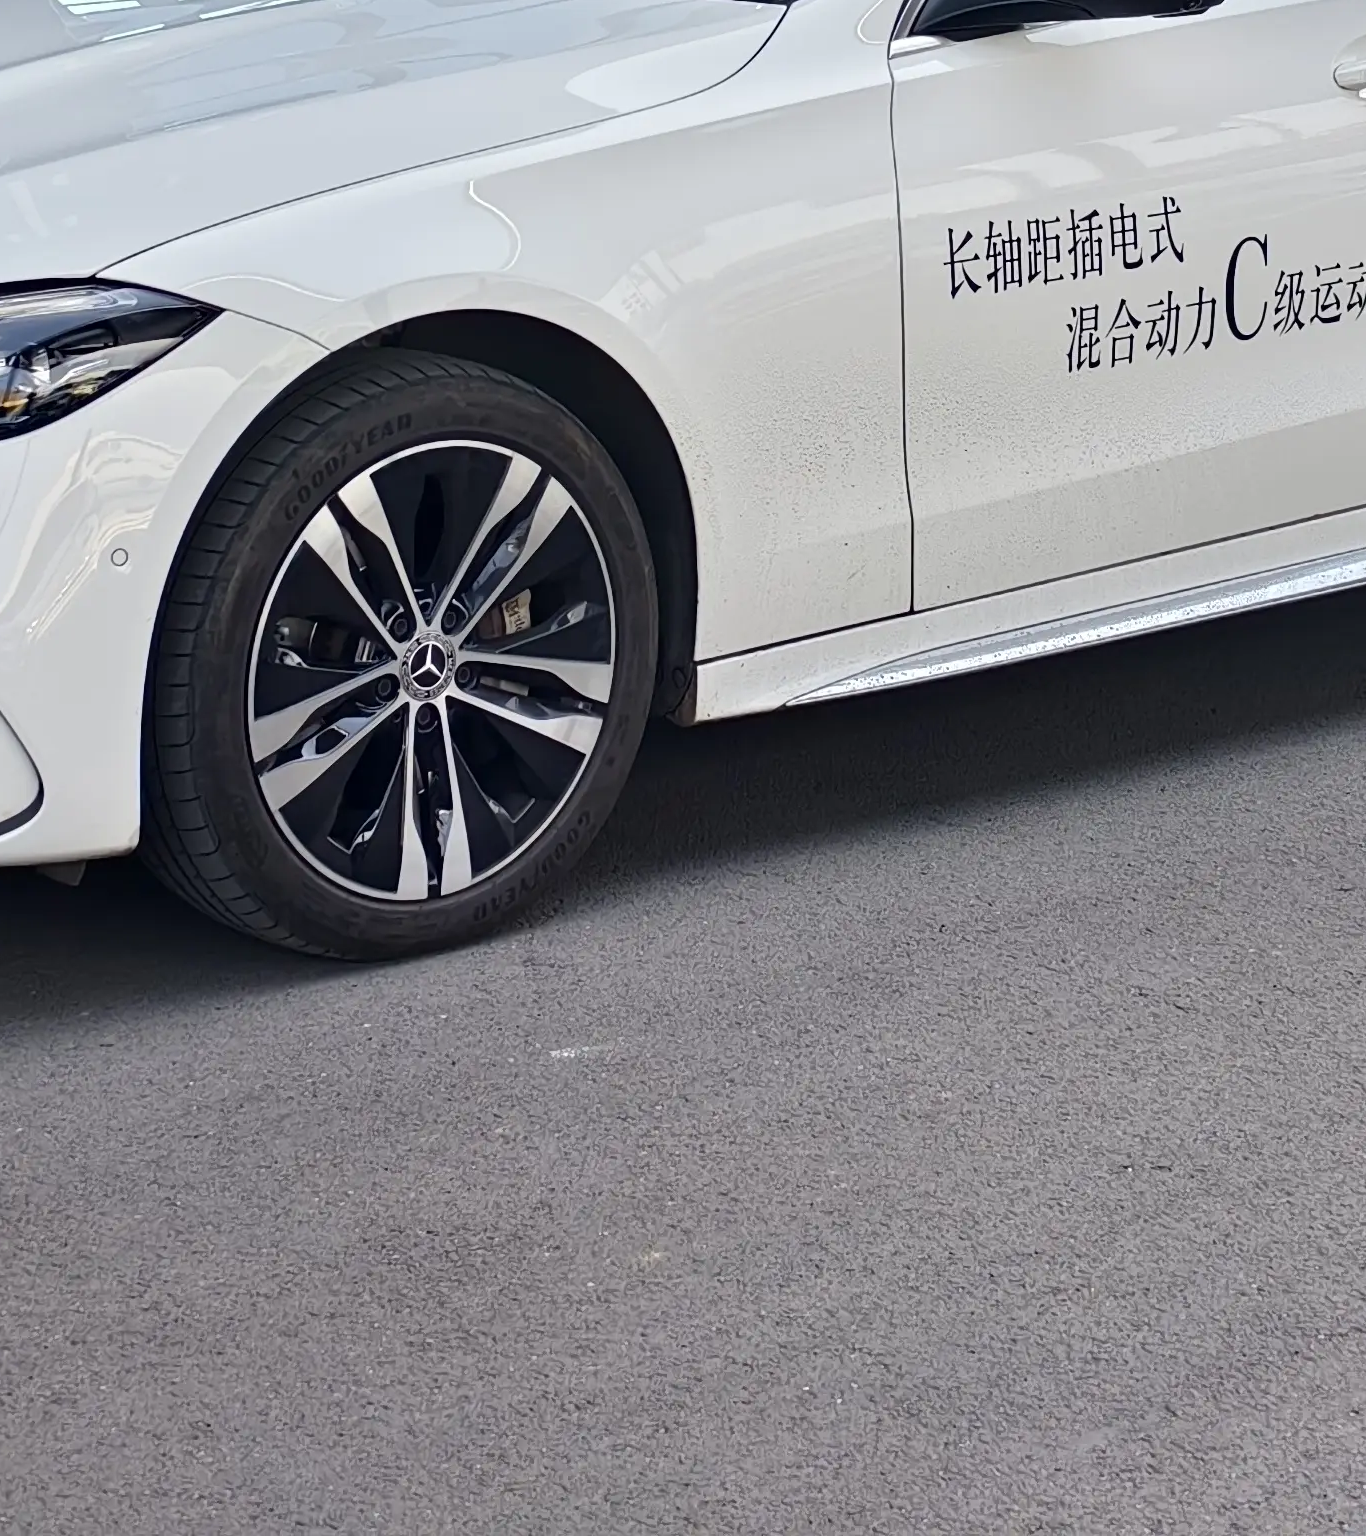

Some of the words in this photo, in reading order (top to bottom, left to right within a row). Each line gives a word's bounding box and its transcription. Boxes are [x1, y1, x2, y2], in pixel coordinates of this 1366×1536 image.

[943, 195, 1185, 300] 长轴距插电式
[284, 412, 413, 522] GOODYEAR
